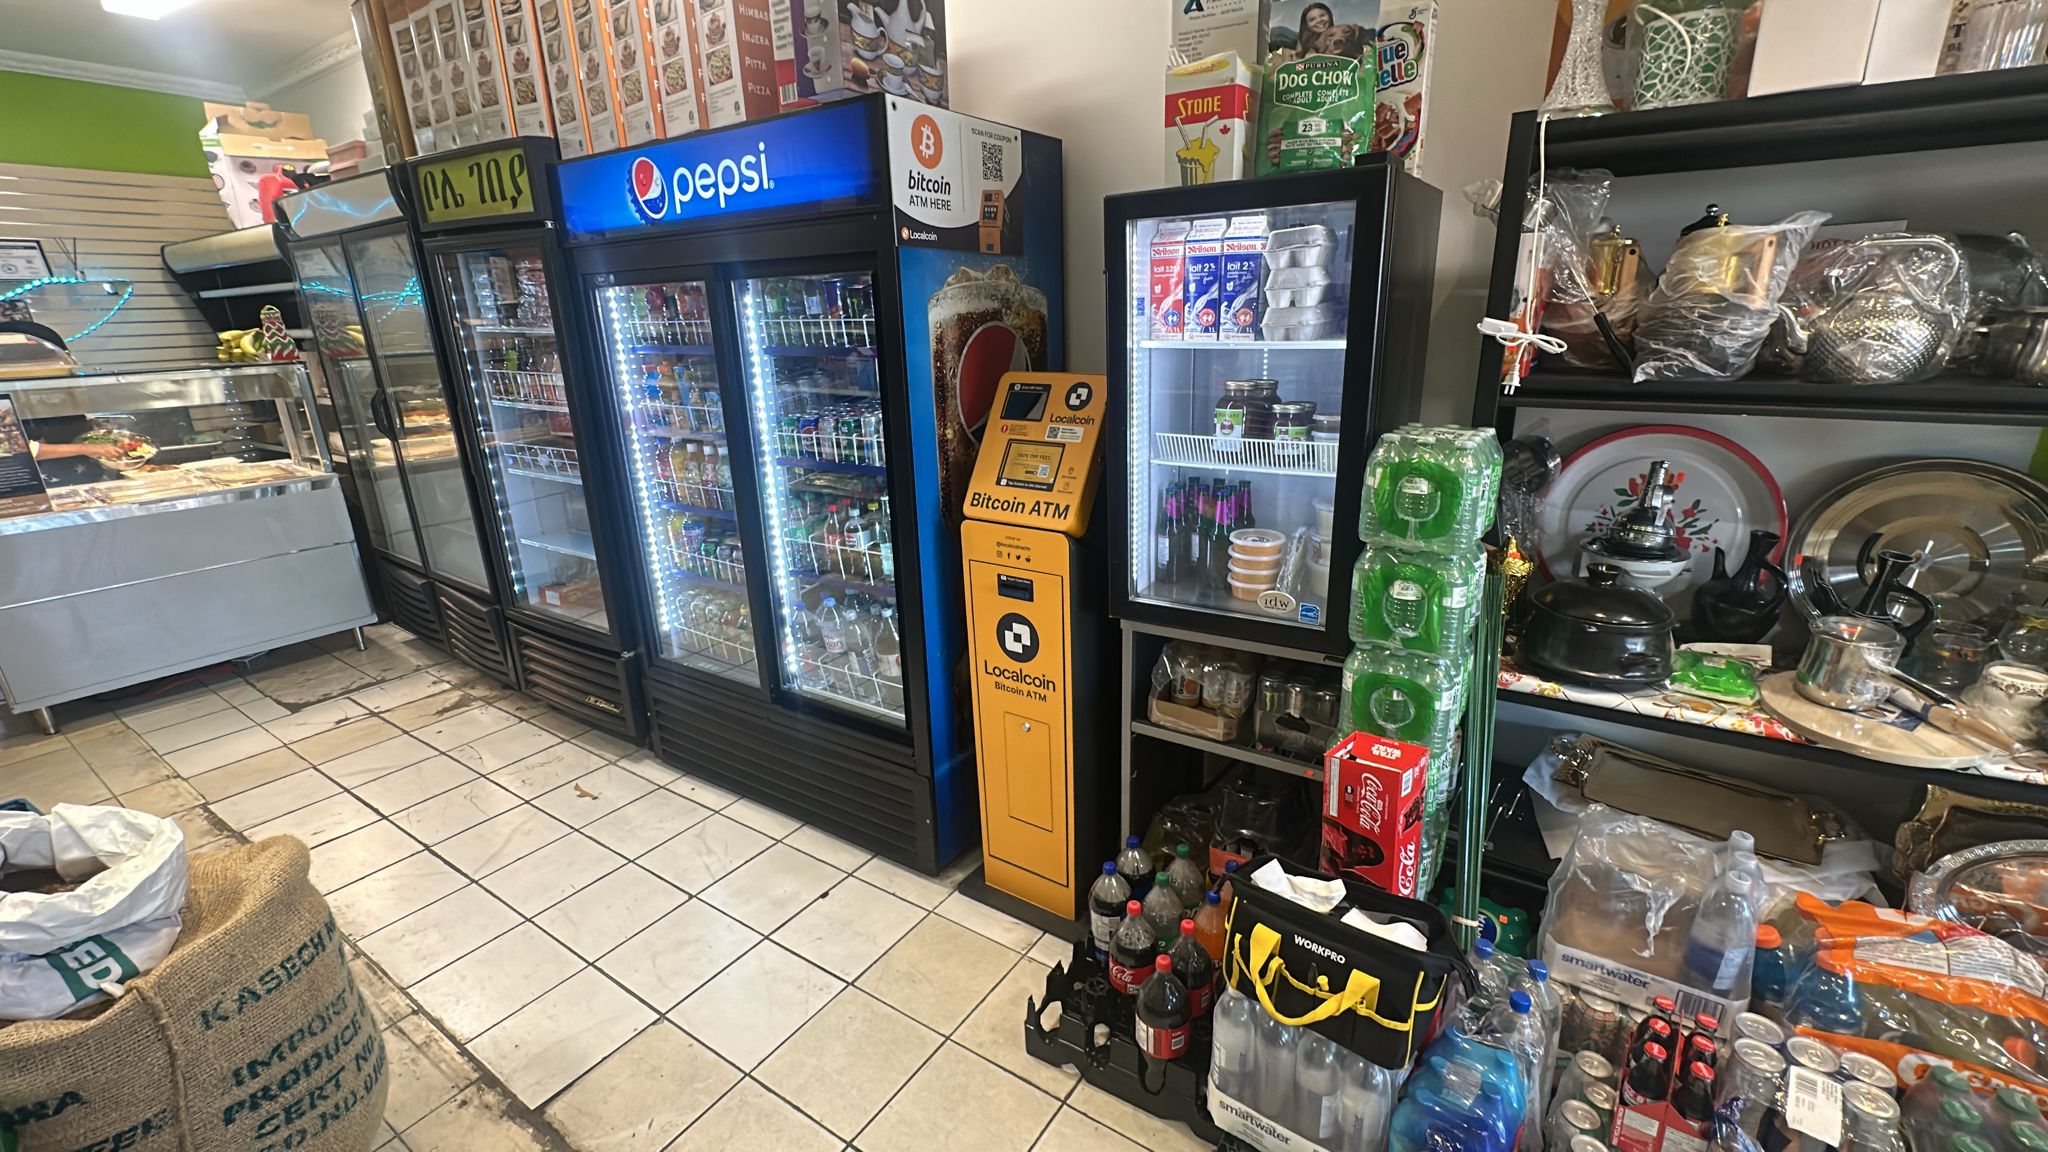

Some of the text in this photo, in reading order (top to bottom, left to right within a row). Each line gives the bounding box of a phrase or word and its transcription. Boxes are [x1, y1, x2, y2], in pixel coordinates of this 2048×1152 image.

[741, 30, 770, 46] INJERA
[744, 56, 767, 71] PITTA
[1305, 61, 1339, 69] PURINA
[747, 82, 771, 96] PIZZA
[1279, 70, 1353, 91] DOG CHOW
[1177, 95, 1221, 118] STONE
[971, 127, 984, 137] SCAN
[984, 130, 993, 139] FOR
[1302, 123, 1313, 133] 23
[673, 141, 769, 215] pepsi
[908, 170, 951, 196] bitcoin
[909, 195, 952, 211] ATM HERE
[909, 229, 938, 241] Localcoin
[1189, 263, 1202, 273] lait
[1227, 261, 1240, 271] lait
[1049, 412, 1095, 425] Localcoin
[970, 492, 1071, 520] Bitcoin ATM
[984, 659, 1056, 692] Localcoin
[994, 681, 1047, 703] Bitcoin ATM
[1398, 840, 1416, 896] Cola
[1294, 934, 1346, 964] WORKPRO
[1561, 953, 1650, 989] smartwater
[222, 1013, 361, 1127] PRODUCE
[1218, 1099, 1291, 1145] smartwater
